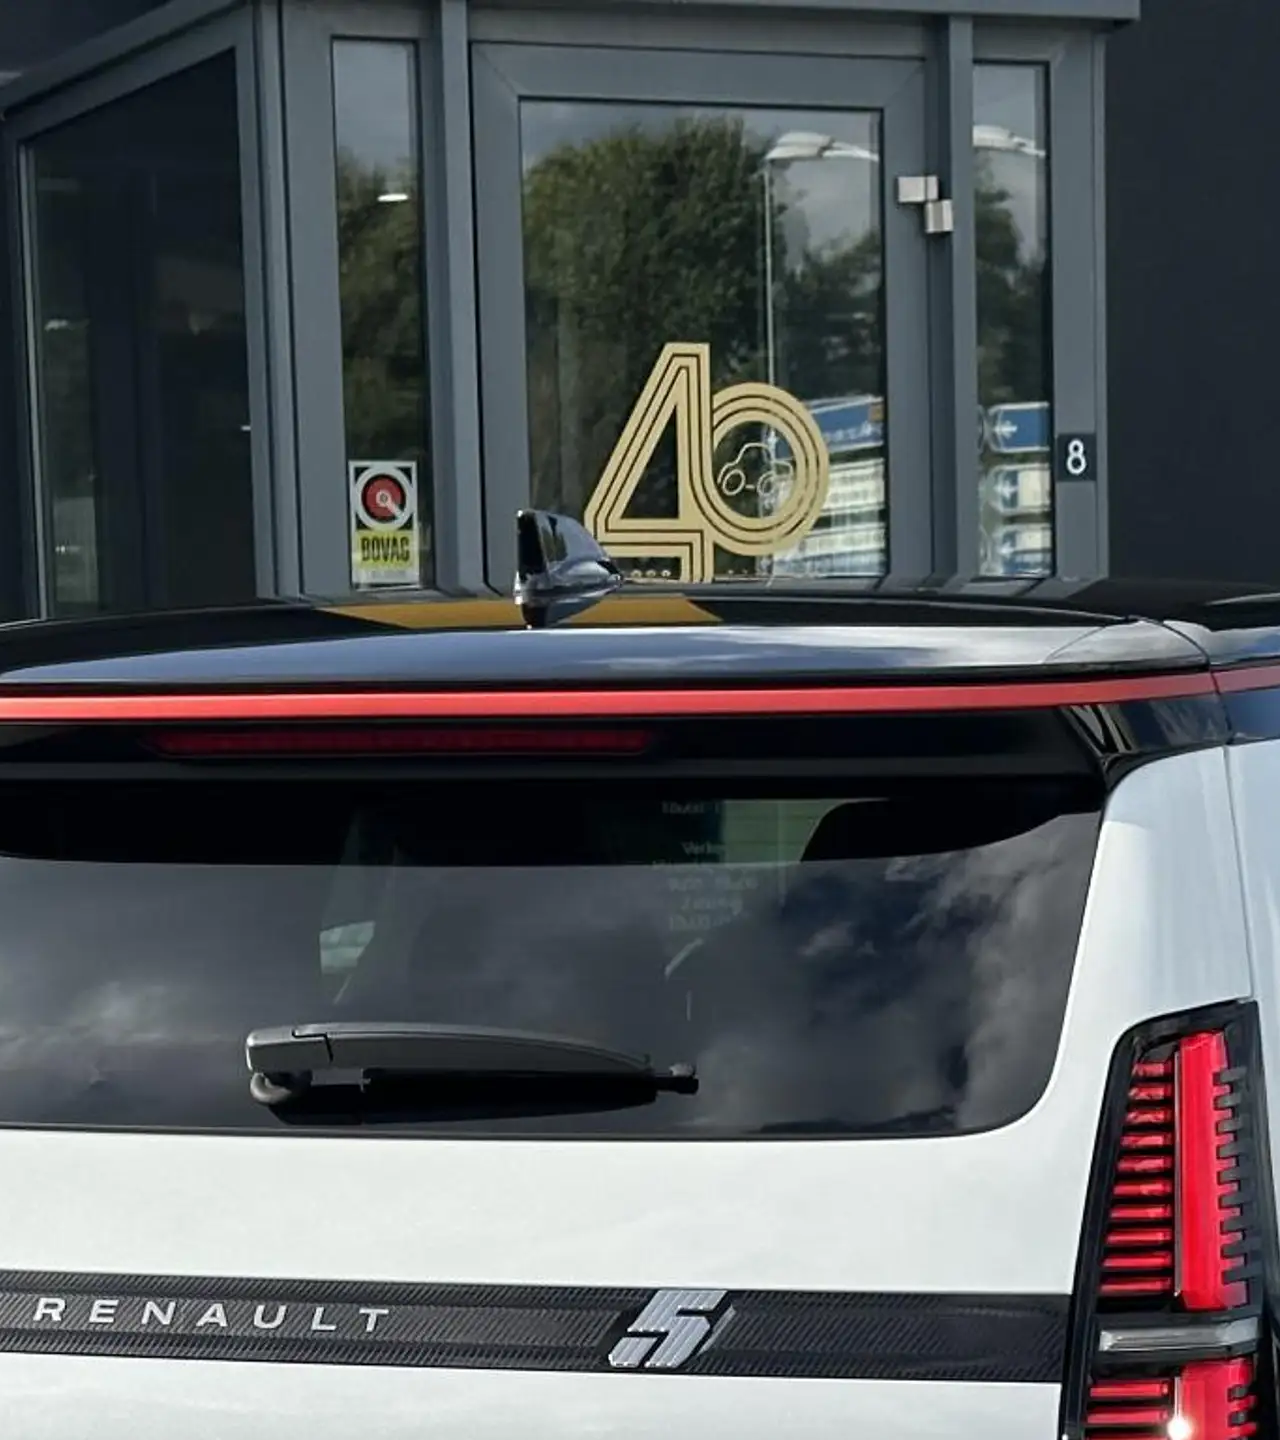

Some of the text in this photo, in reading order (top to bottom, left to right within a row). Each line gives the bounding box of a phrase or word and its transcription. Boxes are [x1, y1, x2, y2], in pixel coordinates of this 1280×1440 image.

[584, 342, 829, 583] 40
[1066, 438, 1088, 476] 8
[33, 1296, 390, 1333] RENAULT
